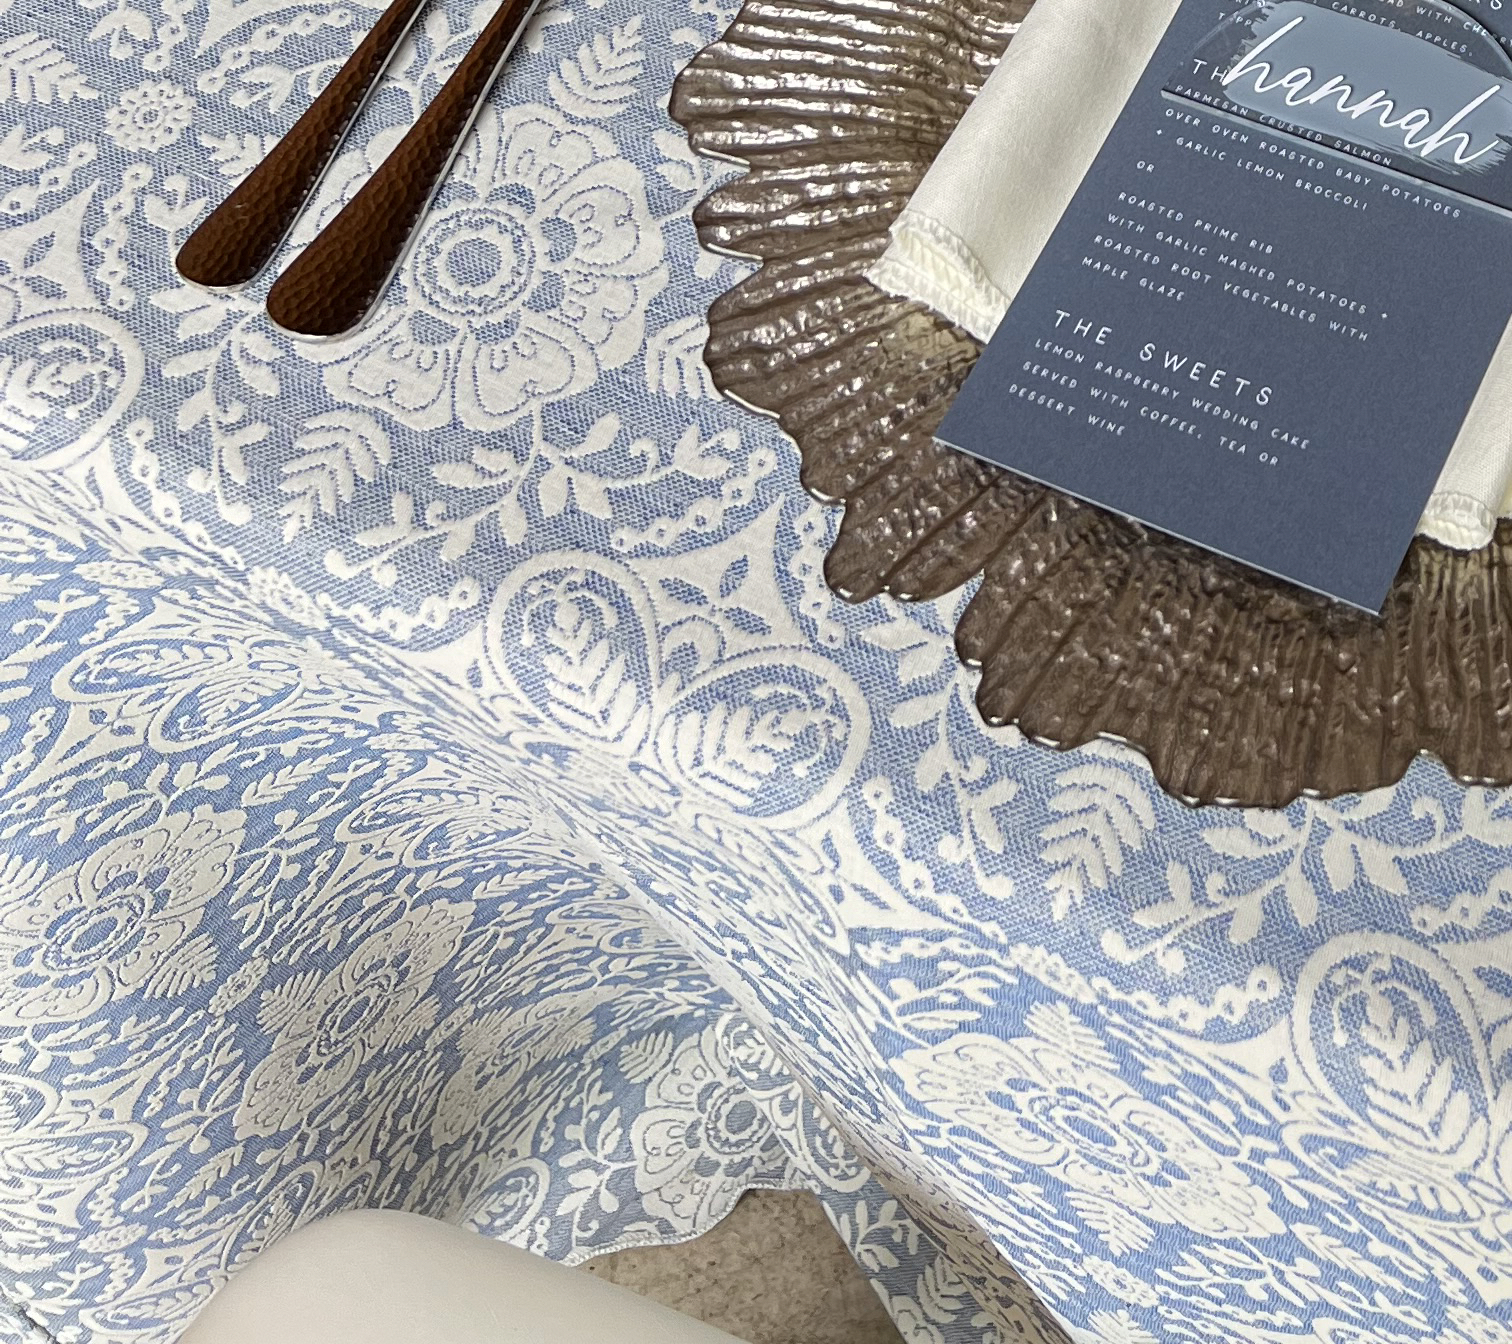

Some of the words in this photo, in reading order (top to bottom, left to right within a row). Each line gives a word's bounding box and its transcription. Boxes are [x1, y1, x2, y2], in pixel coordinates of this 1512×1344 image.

[1416, 5, 1453, 24] WITH
[1193, 58, 1228, 84] TH
[1221, 15, 1500, 165] hannah
[1136, 160, 1156, 174] OR
[1165, 108, 1201, 127] OVER
[1211, 124, 1249, 144] OVEN
[1258, 141, 1324, 171] ROASTED
[1335, 167, 1371, 187] BABY
[1381, 183, 1461, 218] POTATOES
[1174, 84, 1250, 117] PARMESAN
[1259, 114, 1324, 142] CRUSTED
[1333, 139, 1392, 167] SALMON
[1175, 136, 1227, 161] GARLIC
[1236, 157, 1285, 182] LEMON
[1295, 178, 1369, 212] BROCCOLI
[1107, 212, 1146, 234] WITH
[1155, 230, 1208, 257] GARLIC
[1217, 253, 1275, 281] MASHED
[1286, 277, 1368, 314] POTATOES
[1117, 191, 1184, 223] ROASTED
[1194, 218, 1239, 242] PRIME
[1249, 238, 1274, 254] RIB
[1081, 256, 1129, 281] MAPLE
[1138, 277, 1185, 302] GLAZE
[1093, 234, 1160, 265] ROASTED
[1170, 262, 1212, 285] ROOT
[1223, 281, 1317, 324] VEGETABLES
[1329, 319, 1369, 342] WITH
[1034, 338, 1086, 364] LEMON
[1094, 360, 1180, 401] RASPBERRY
[1191, 396, 1260, 431] WEDDING
[1270, 427, 1310, 450] CAKE
[1054, 308, 1113, 346] THE
[1138, 342, 1273, 406] SWEETS
[1008, 383, 1076, 416] DESSERT
[1087, 413, 1126, 436] WINE
[1022, 360, 1078, 389] SERVED
[1090, 385, 1130, 409] WITH
[1219, 435, 1247, 455] TEA
[1258, 451, 1279, 466] OR
